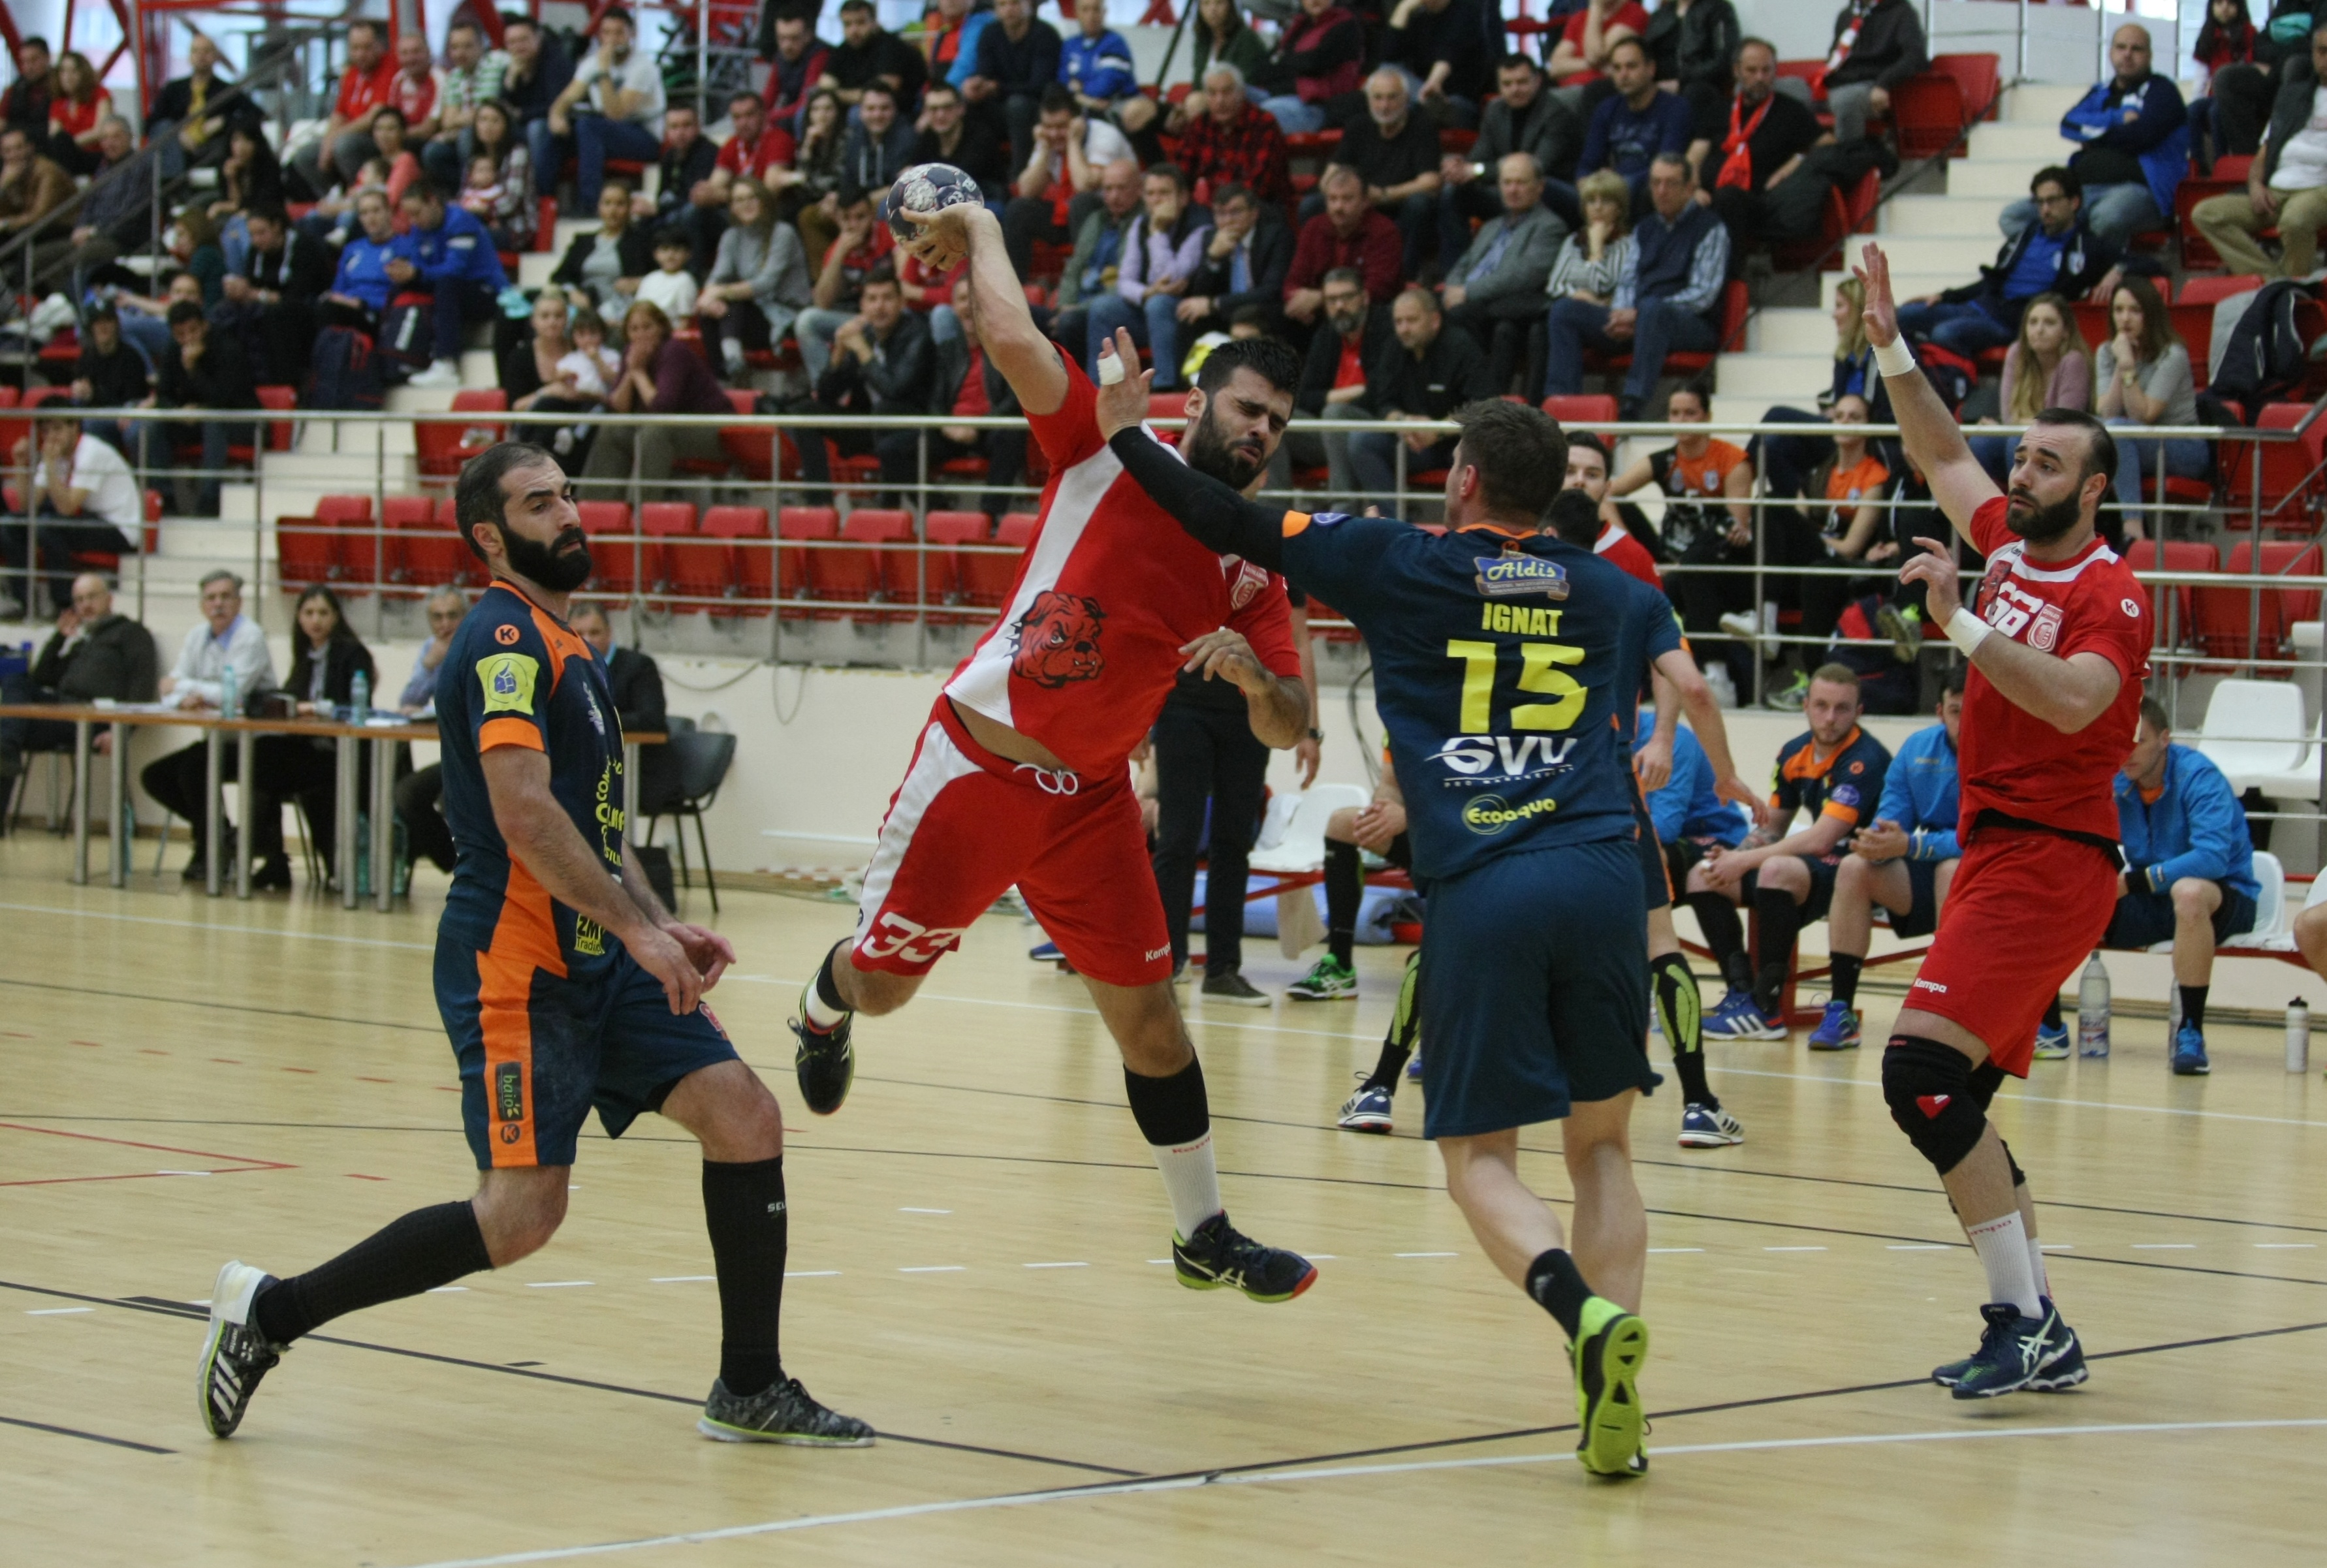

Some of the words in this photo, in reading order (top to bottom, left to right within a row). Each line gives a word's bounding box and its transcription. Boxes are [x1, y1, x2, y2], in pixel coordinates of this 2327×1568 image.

[1487, 561, 1557, 581] Aldis
[1481, 602, 1563, 637] IGNAT
[1446, 639, 1588, 734] 15
[861, 911, 968, 964] 33
[1145, 941, 1171, 962] Kemp
[1914, 977, 1948, 994] Kempa
[767, 1201, 785, 1213] SEL
